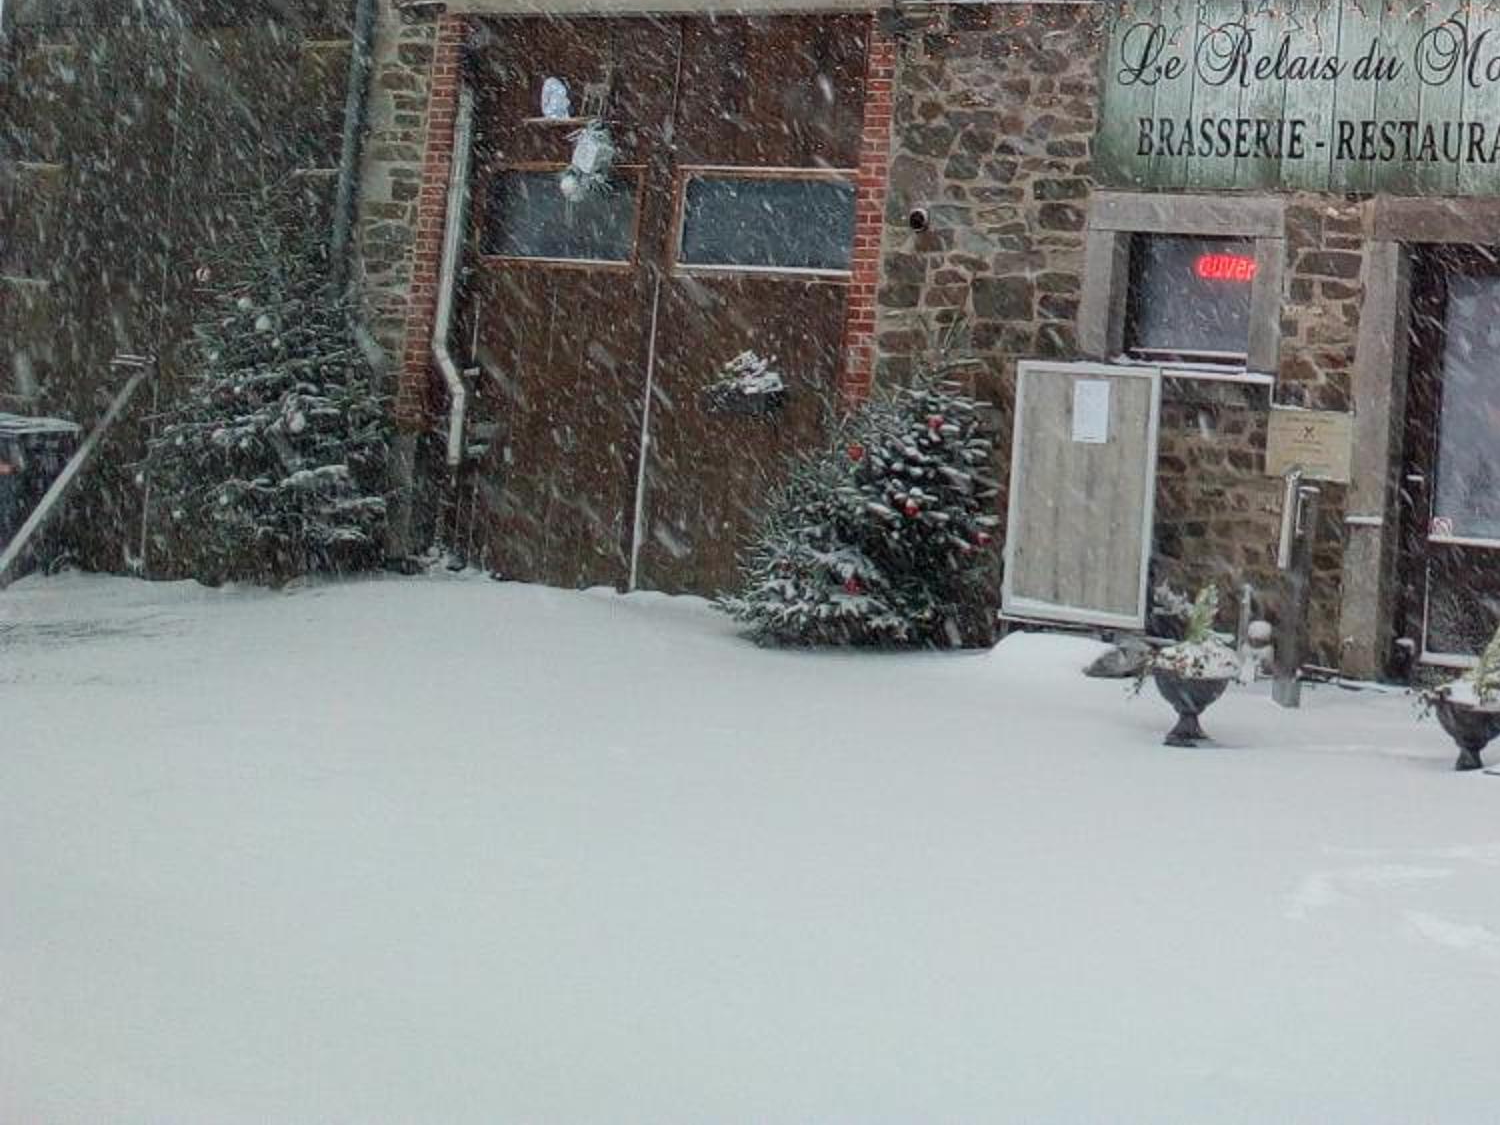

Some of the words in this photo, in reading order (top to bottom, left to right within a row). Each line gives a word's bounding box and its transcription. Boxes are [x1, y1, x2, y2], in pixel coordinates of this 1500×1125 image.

[1117, 23, 1184, 87] Le
[1197, 22, 1345, 88] Relais
[1352, 38, 1404, 83] du
[1136, 118, 1306, 158] BRASSERIE
